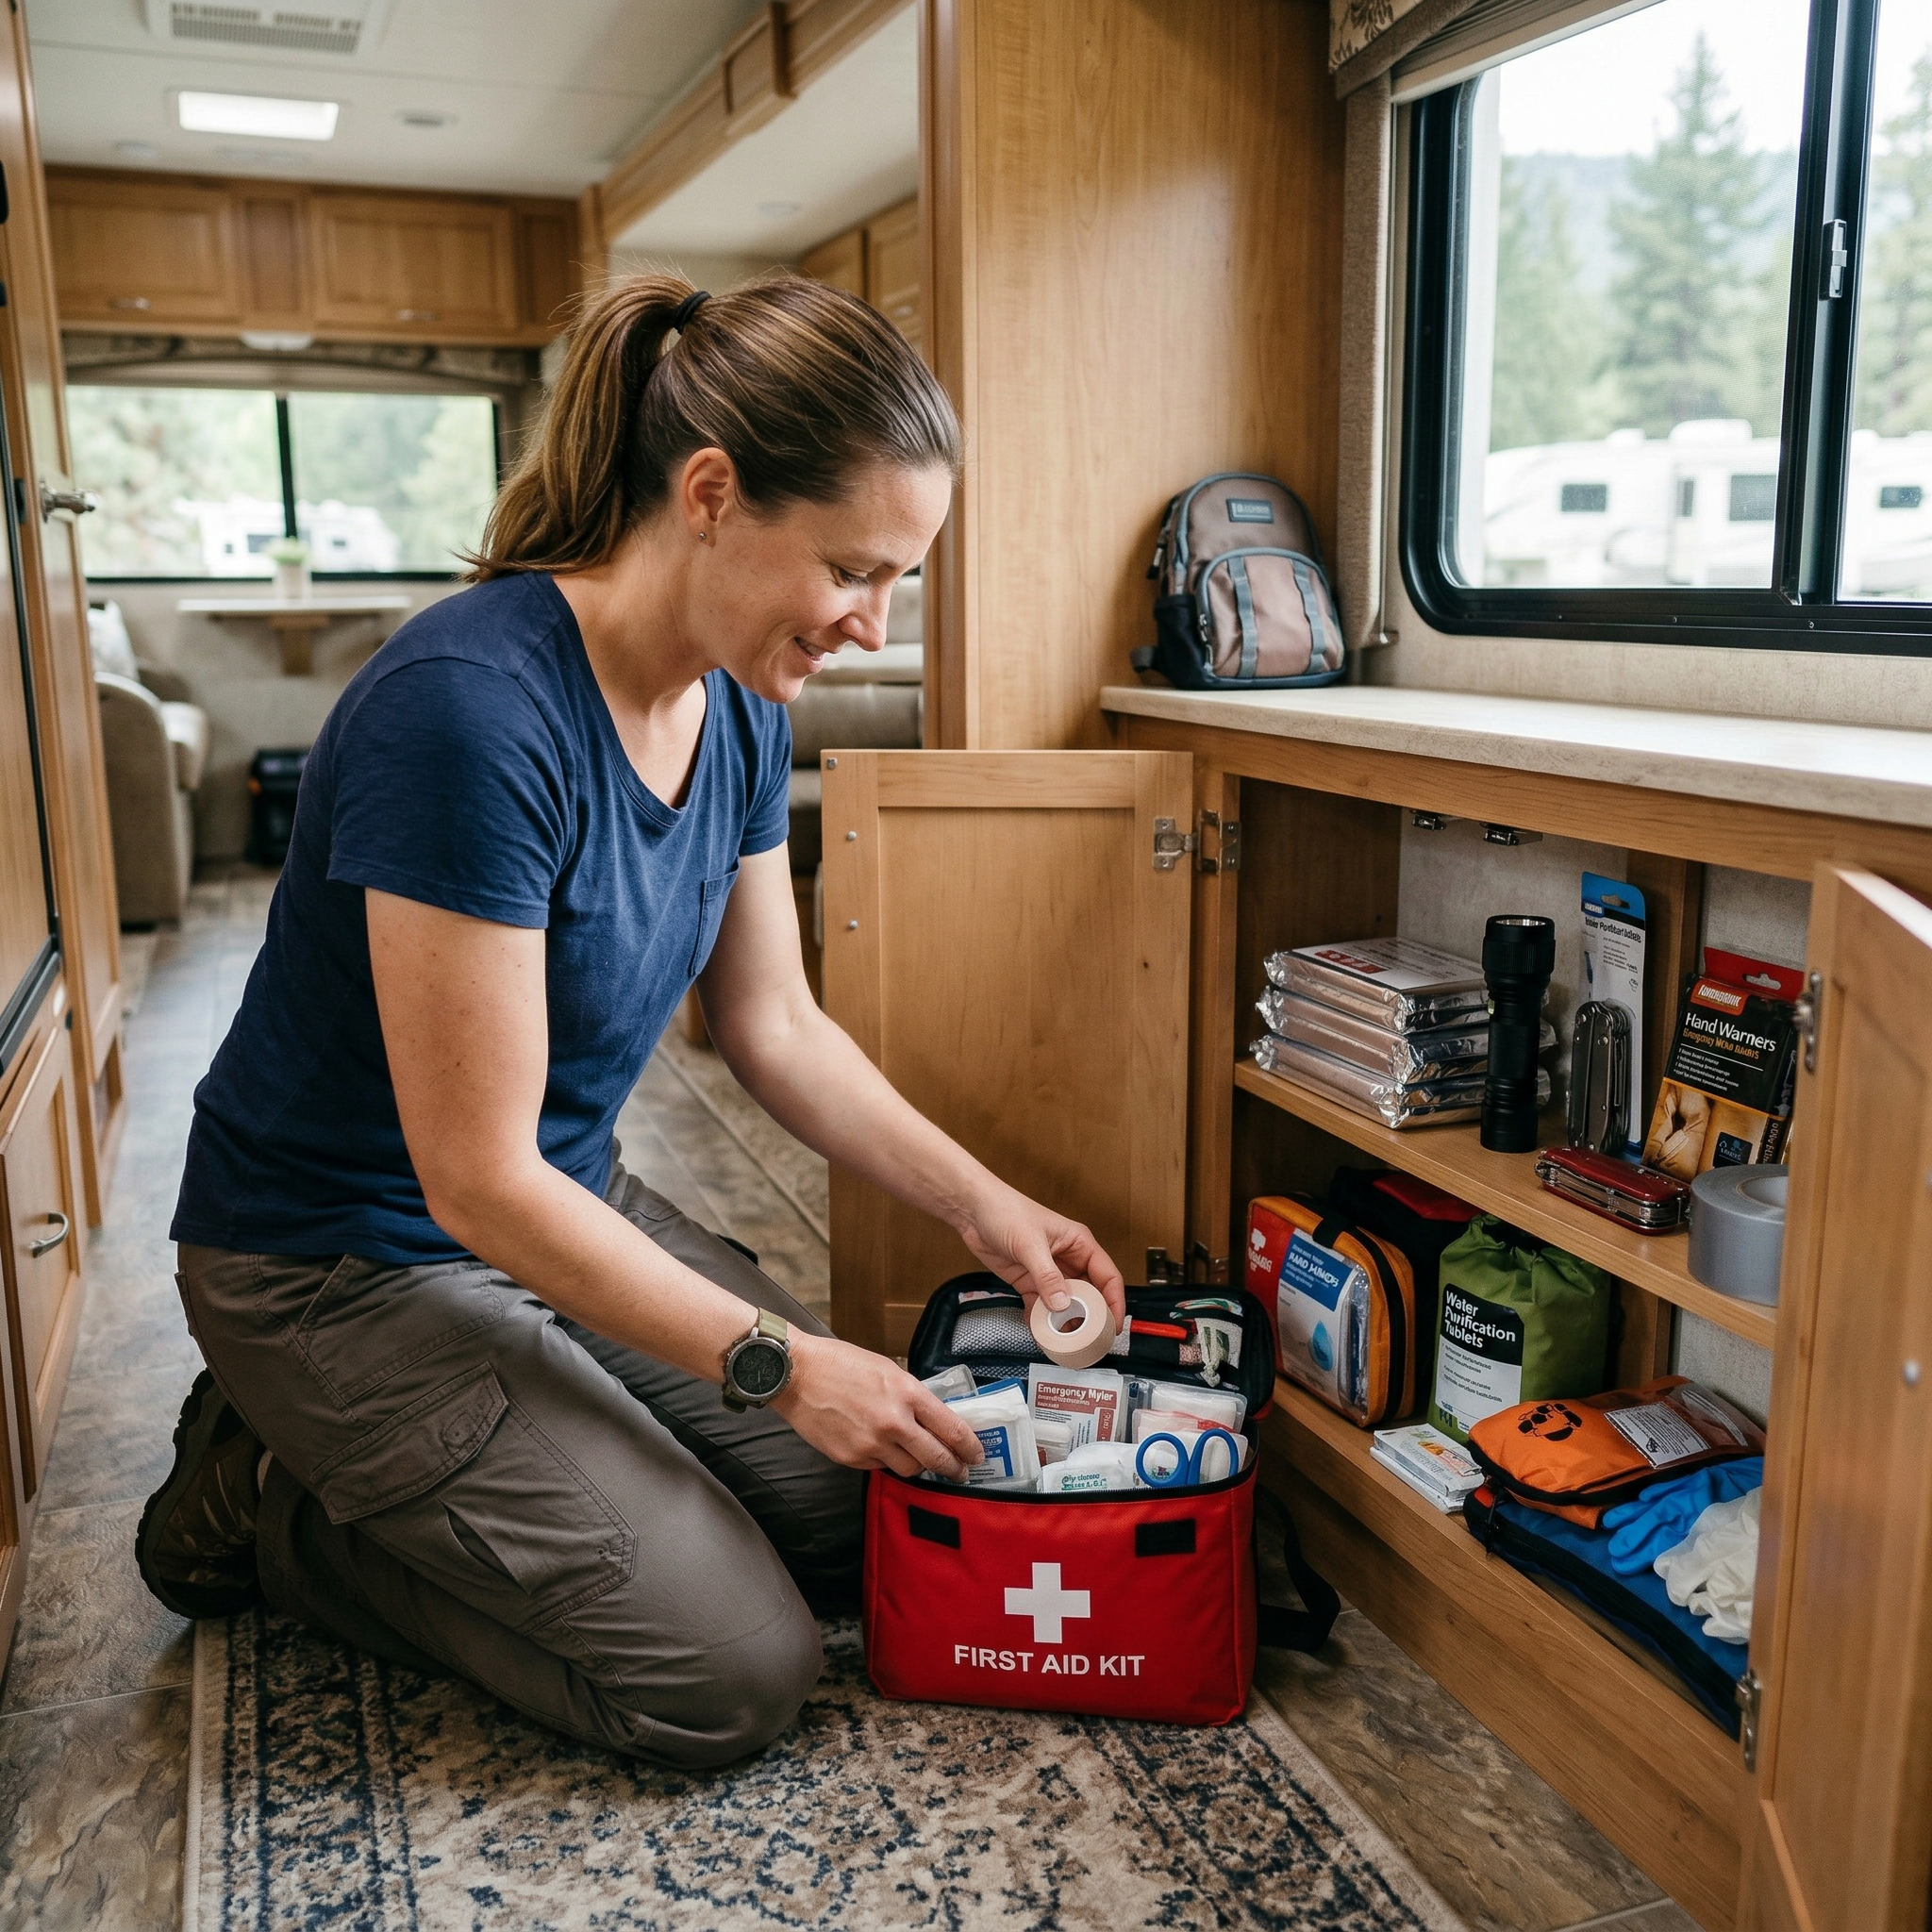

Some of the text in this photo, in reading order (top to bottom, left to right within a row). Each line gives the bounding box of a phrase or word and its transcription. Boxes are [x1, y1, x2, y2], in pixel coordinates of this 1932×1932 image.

[1685, 1012, 1718, 1034] Hand
[1719, 1022, 1777, 1052] Warners
[1446, 1291, 1479, 1317] Water
[955, 1644, 1145, 1676] FIRST AID KIT
